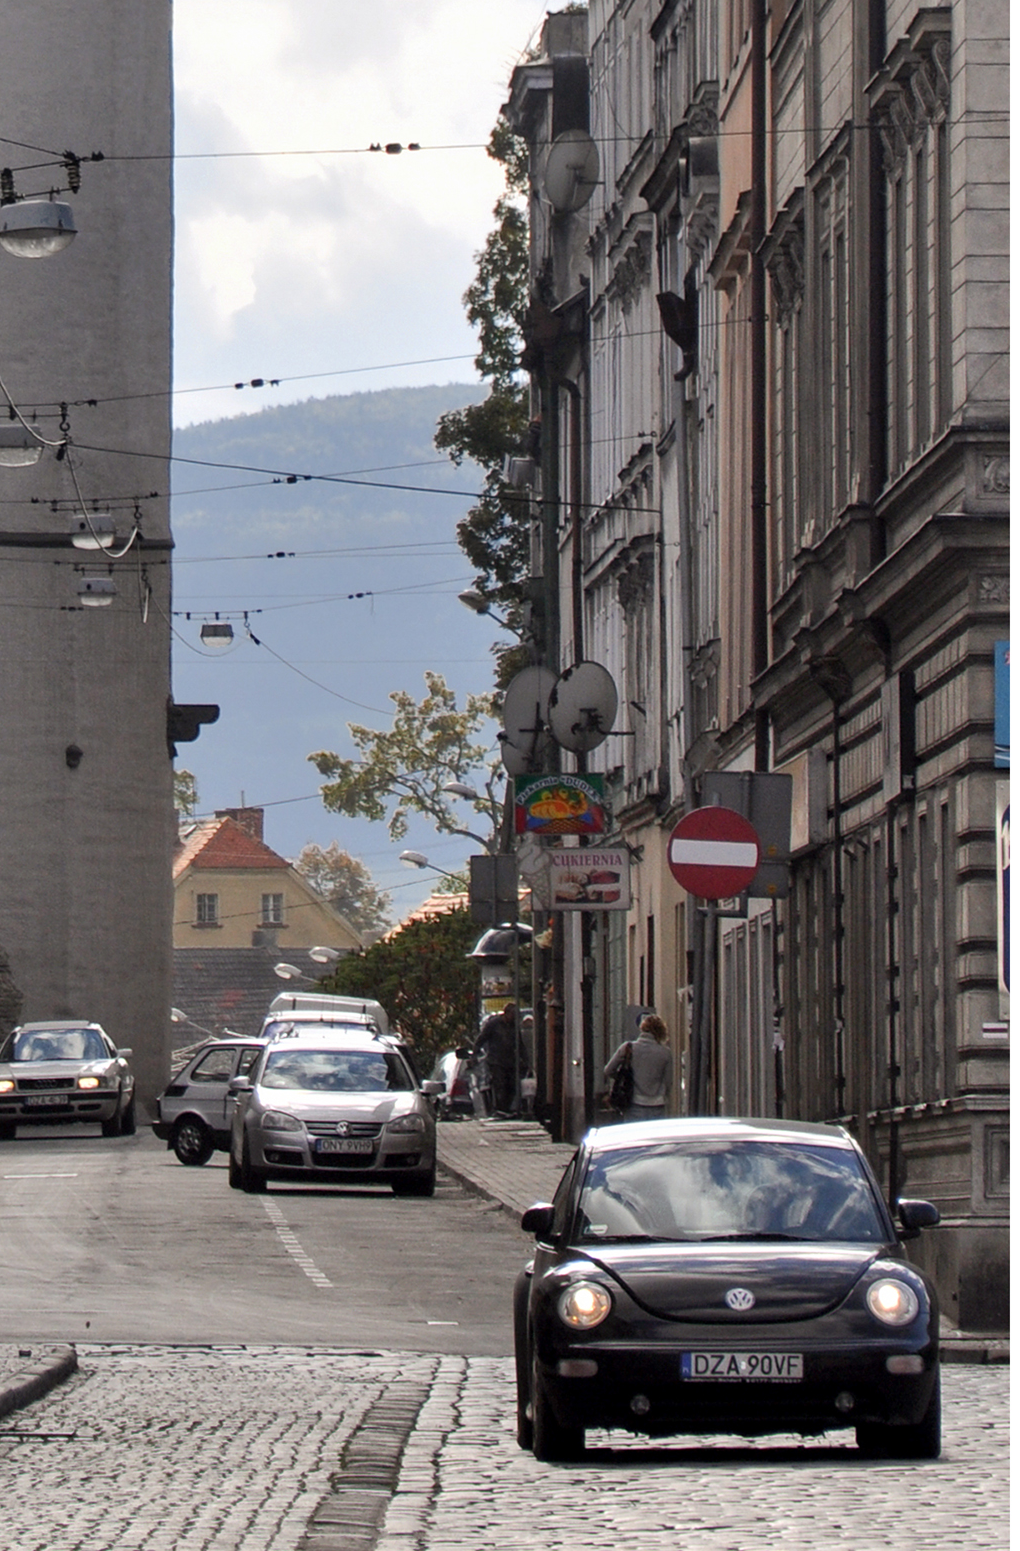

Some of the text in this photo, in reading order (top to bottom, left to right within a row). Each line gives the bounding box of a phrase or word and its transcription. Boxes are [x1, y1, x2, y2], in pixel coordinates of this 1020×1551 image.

[516, 777, 559, 805] Piekarnia
[552, 854, 622, 867] CUKIERNIA
[322, 1140, 343, 1150] ONY
[694, 1354, 800, 1375] DZA 90VF
